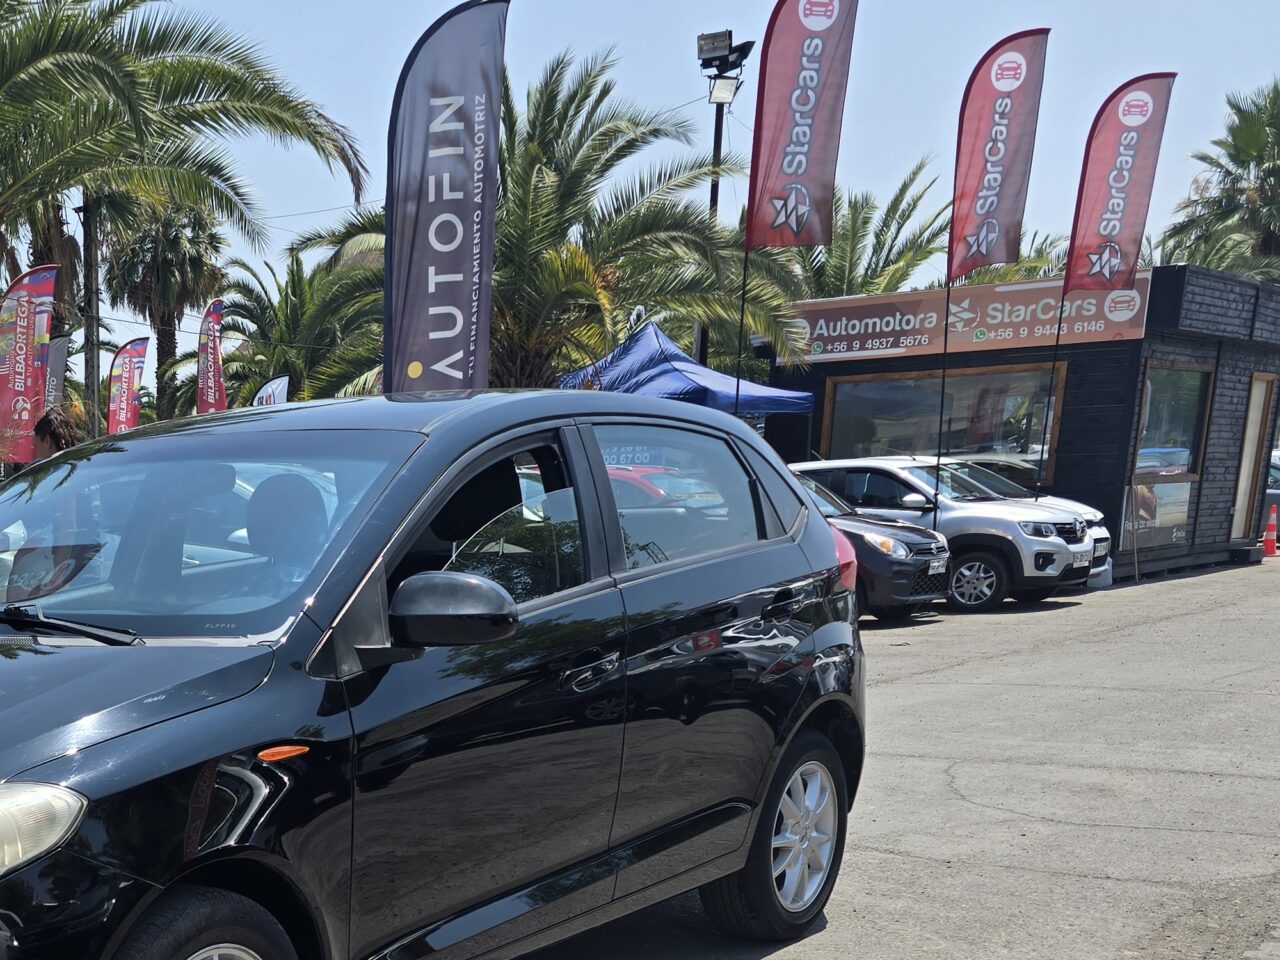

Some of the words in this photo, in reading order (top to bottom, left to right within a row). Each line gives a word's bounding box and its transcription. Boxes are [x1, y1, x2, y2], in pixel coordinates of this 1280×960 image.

[474, 93, 486, 203] AUTOMOTRIZ
[781, 35, 823, 176] StarCars
[976, 95, 1013, 217] StarCars
[1099, 129, 1138, 237] StarCars
[470, 210, 482, 351] FINANCIAMIENTO
[813, 312, 937, 338] Automotora
[986, 298, 1097, 324] StarCars
[15, 295, 29, 392] BILBAORTEGA
[207, 322, 215, 404] BILBAORTEGA
[468, 356, 475, 377] TU
[826, 341, 847, 352] +56
[852, 340, 860, 351] 9
[865, 337, 895, 350] 4937
[900, 334, 929, 347] 5676
[988, 327, 1013, 340] +56
[1020, 326, 1028, 338] 9
[1034, 323, 1068, 337] 9443
[1074, 320, 1105, 333] 6146
[120, 357, 131, 422] BILBAORTEGA
